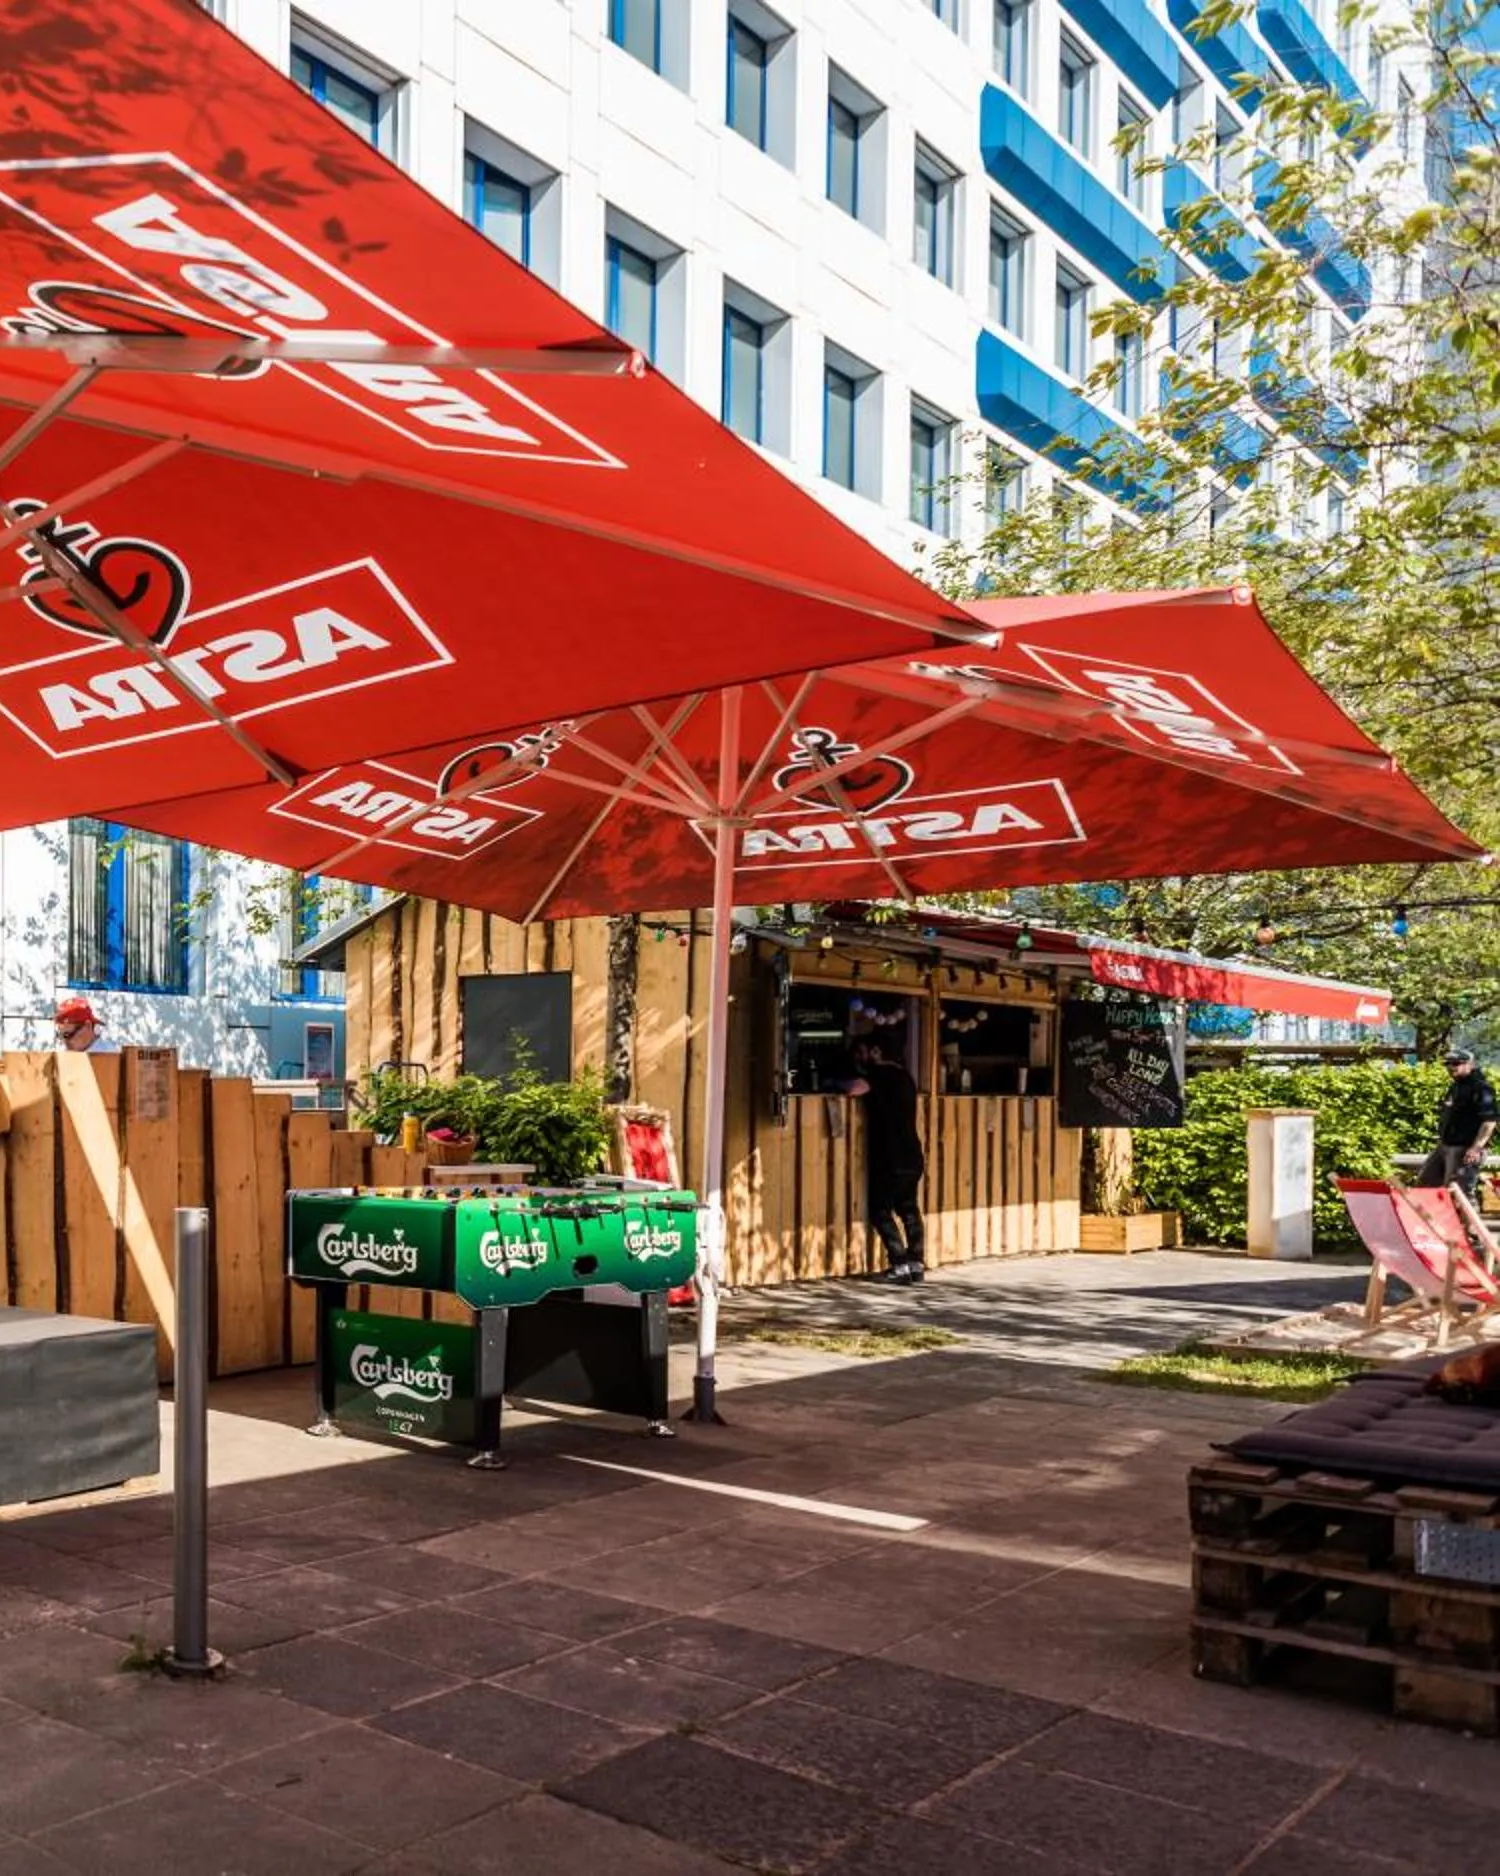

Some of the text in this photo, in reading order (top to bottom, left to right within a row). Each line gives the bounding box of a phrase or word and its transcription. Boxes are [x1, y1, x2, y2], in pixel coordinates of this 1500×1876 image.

[318, 1223, 418, 1274] Carlsberg
[624, 1221, 681, 1259] Carlsberg
[351, 1344, 453, 1401] Carlsberg
